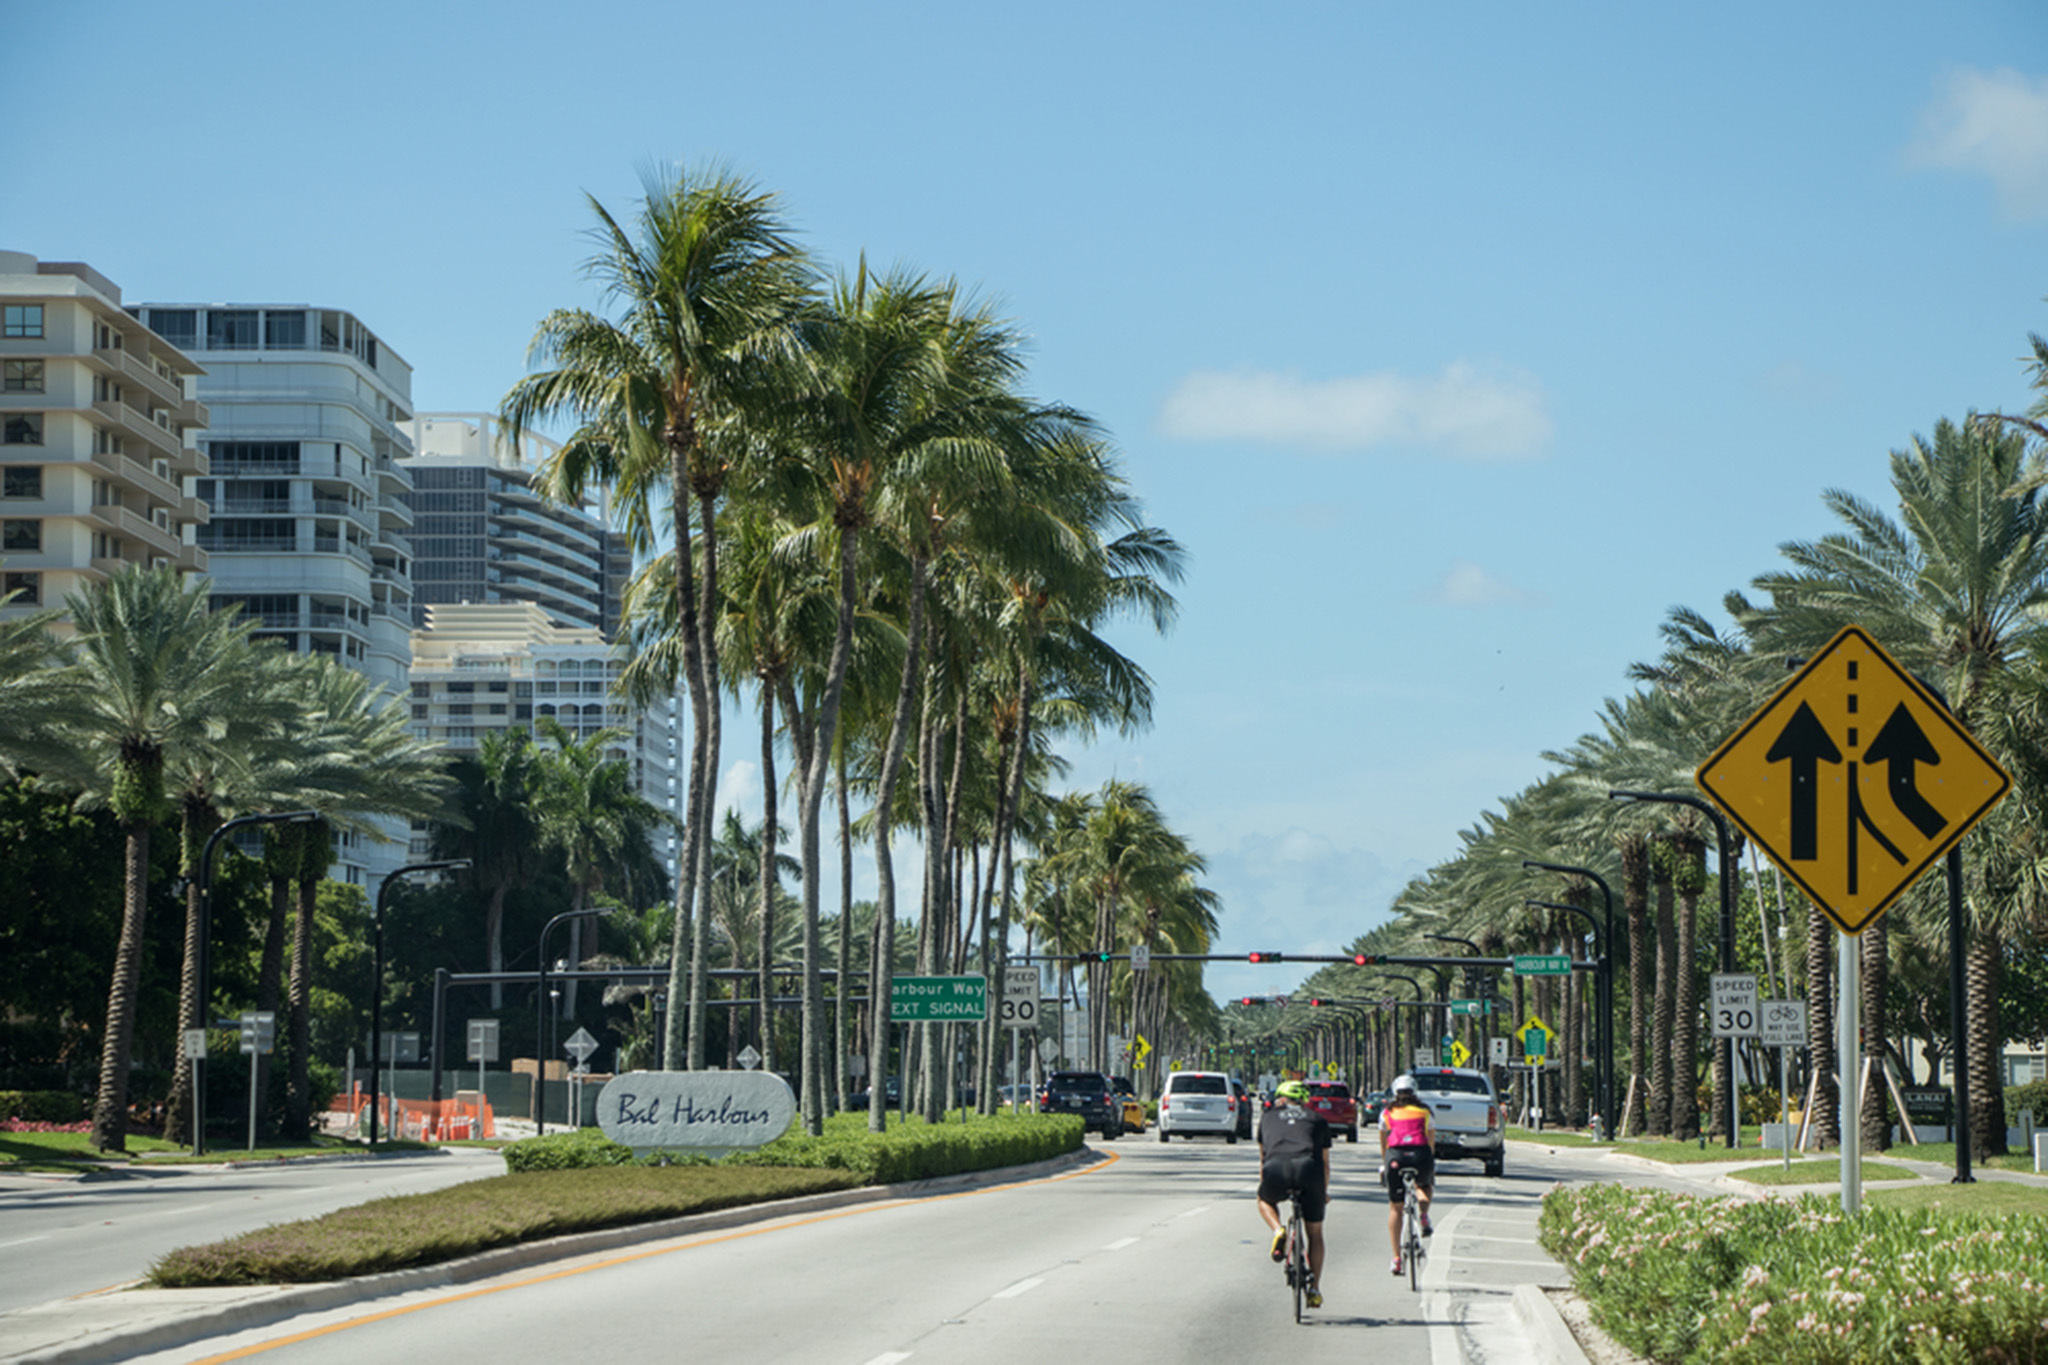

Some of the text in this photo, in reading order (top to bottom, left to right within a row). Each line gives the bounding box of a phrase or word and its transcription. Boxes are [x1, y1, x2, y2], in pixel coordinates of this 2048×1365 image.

[1006, 972, 1037, 982] PEED
[892, 982, 985, 998] arbour Way
[1715, 981, 1754, 991] SPEED
[1720, 996, 1749, 1005] LIMIT
[891, 1002, 984, 1015] EXT SIGNAL
[1001, 1000, 1034, 1020] 30
[1718, 1010, 1753, 1030] 30
[617, 1093, 769, 1125] Bal Harbour
